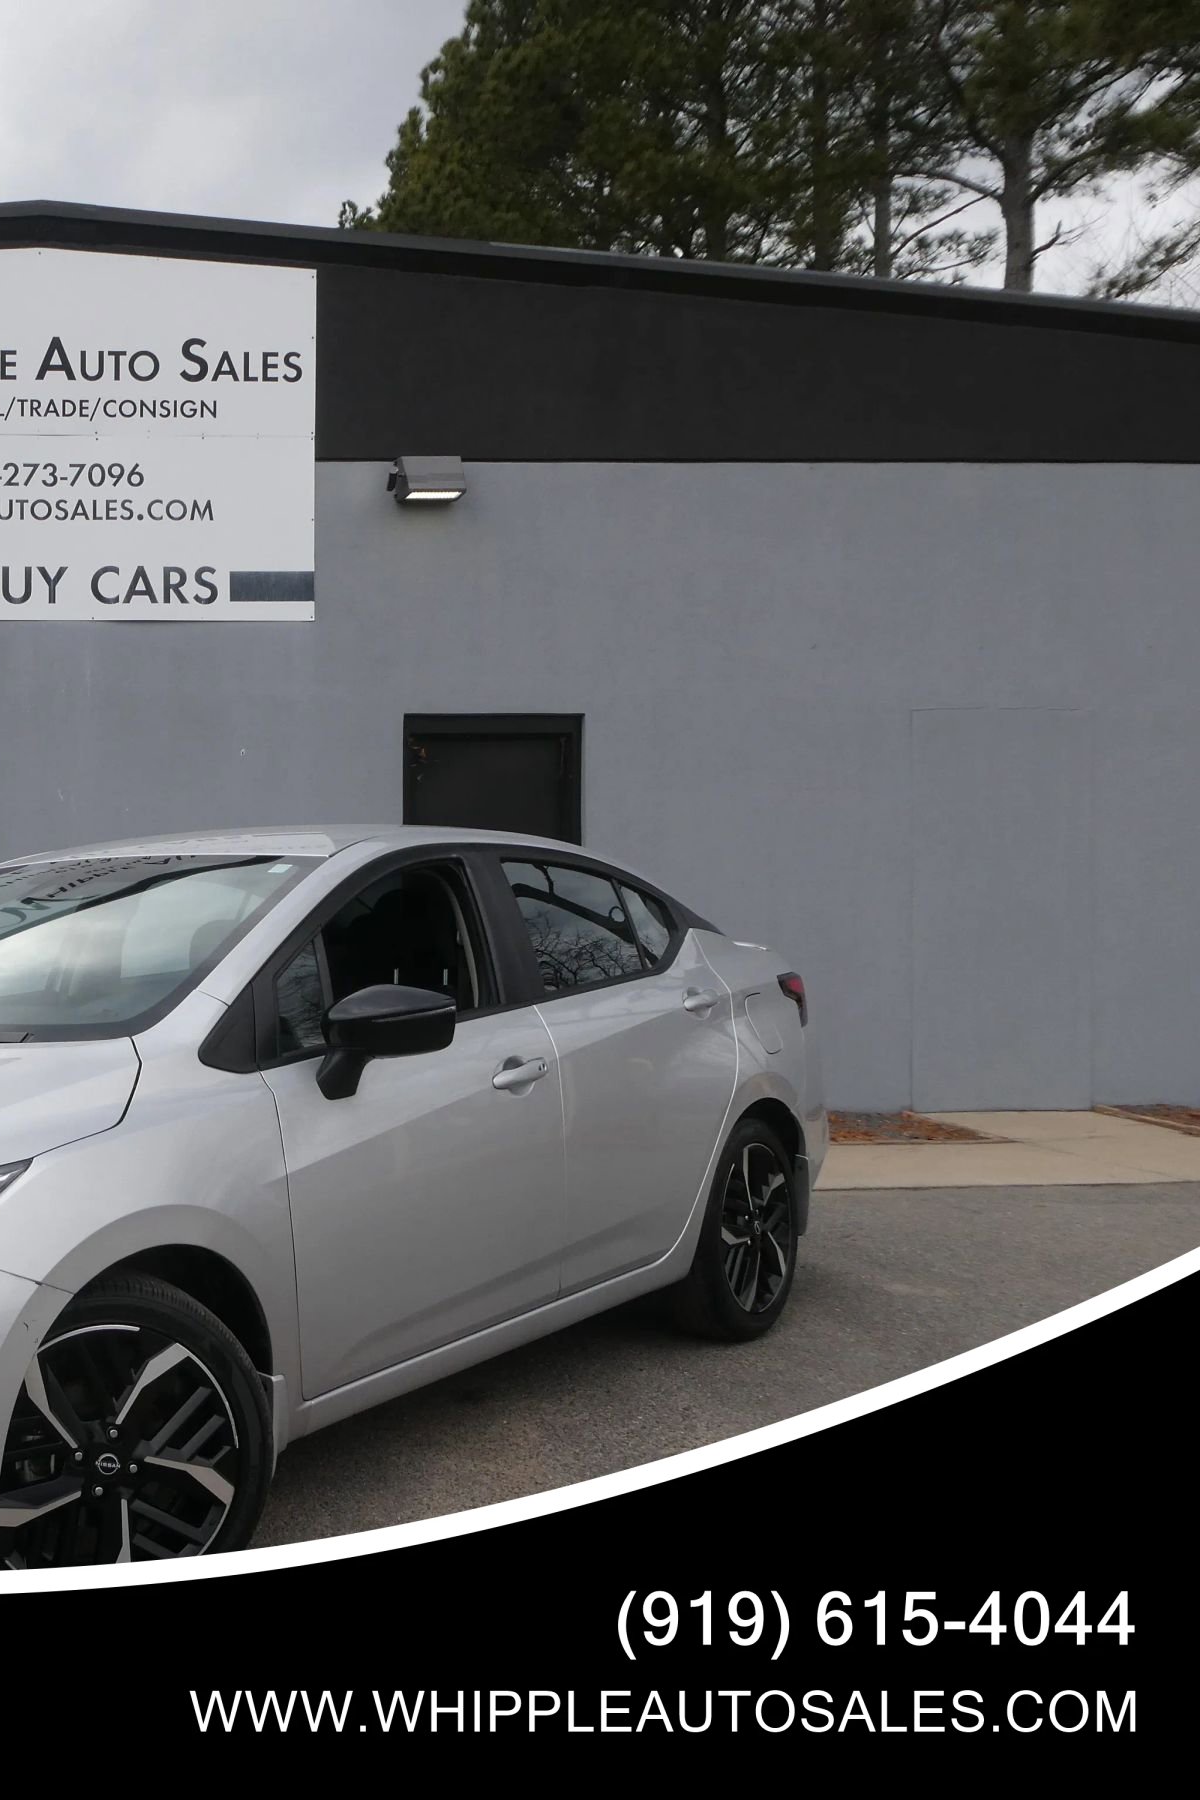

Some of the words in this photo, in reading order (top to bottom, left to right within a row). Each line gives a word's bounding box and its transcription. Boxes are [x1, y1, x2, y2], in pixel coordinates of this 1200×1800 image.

[35, 336, 160, 382] AUTO
[180, 337, 303, 383] SALES
[90, 565, 219, 605] CARS
